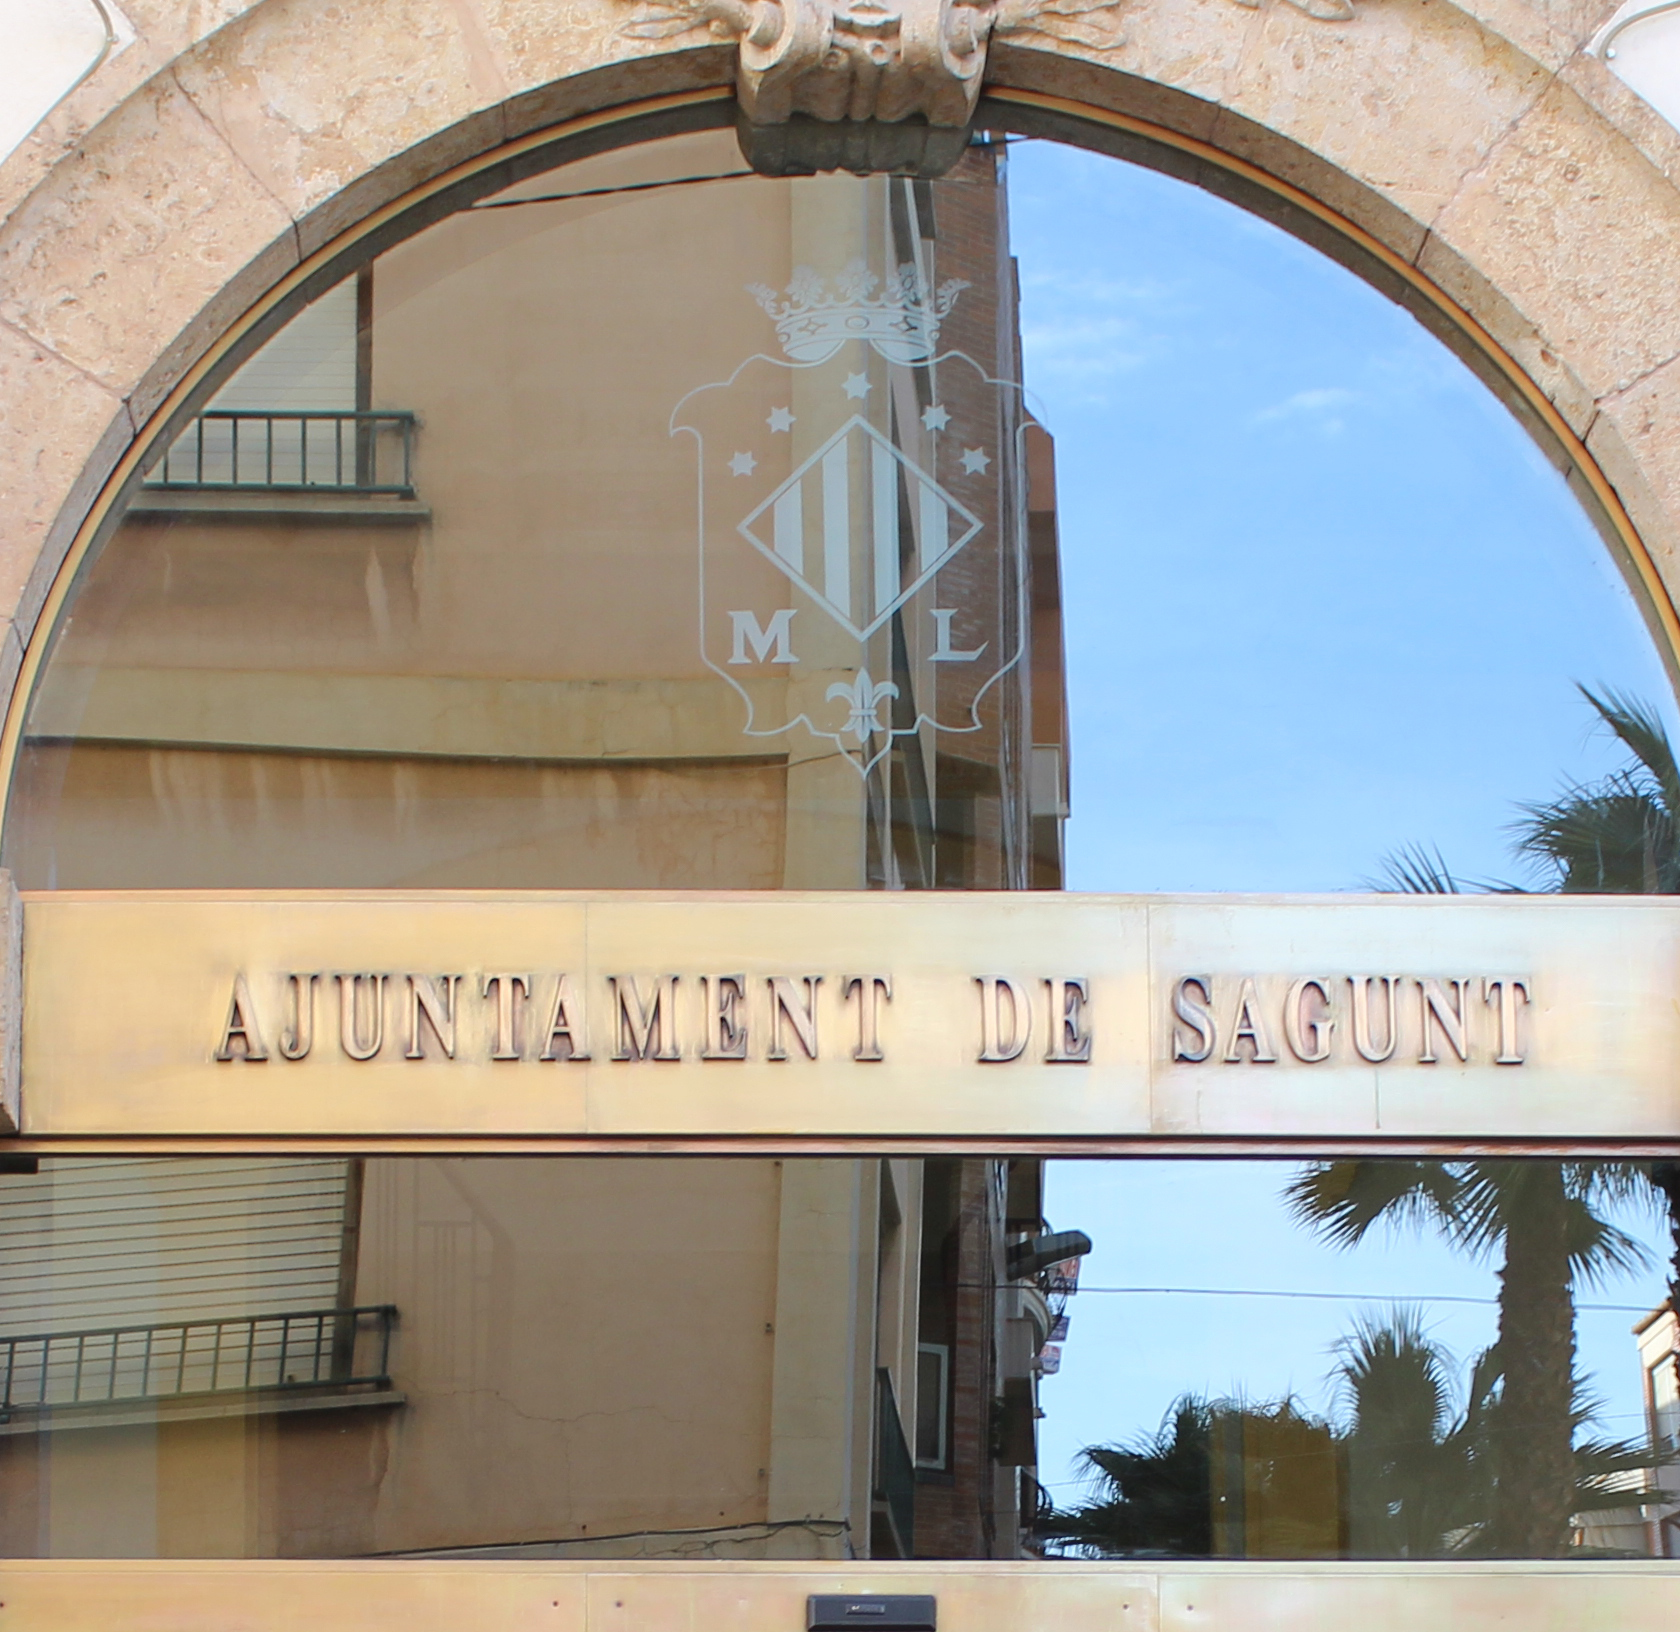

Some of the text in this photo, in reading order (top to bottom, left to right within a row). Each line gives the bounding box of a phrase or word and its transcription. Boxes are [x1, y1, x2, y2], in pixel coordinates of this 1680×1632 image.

[727, 607, 989, 665] M L
[214, 972, 1532, 1065] AJUNTAMENT DE SAGUNT
